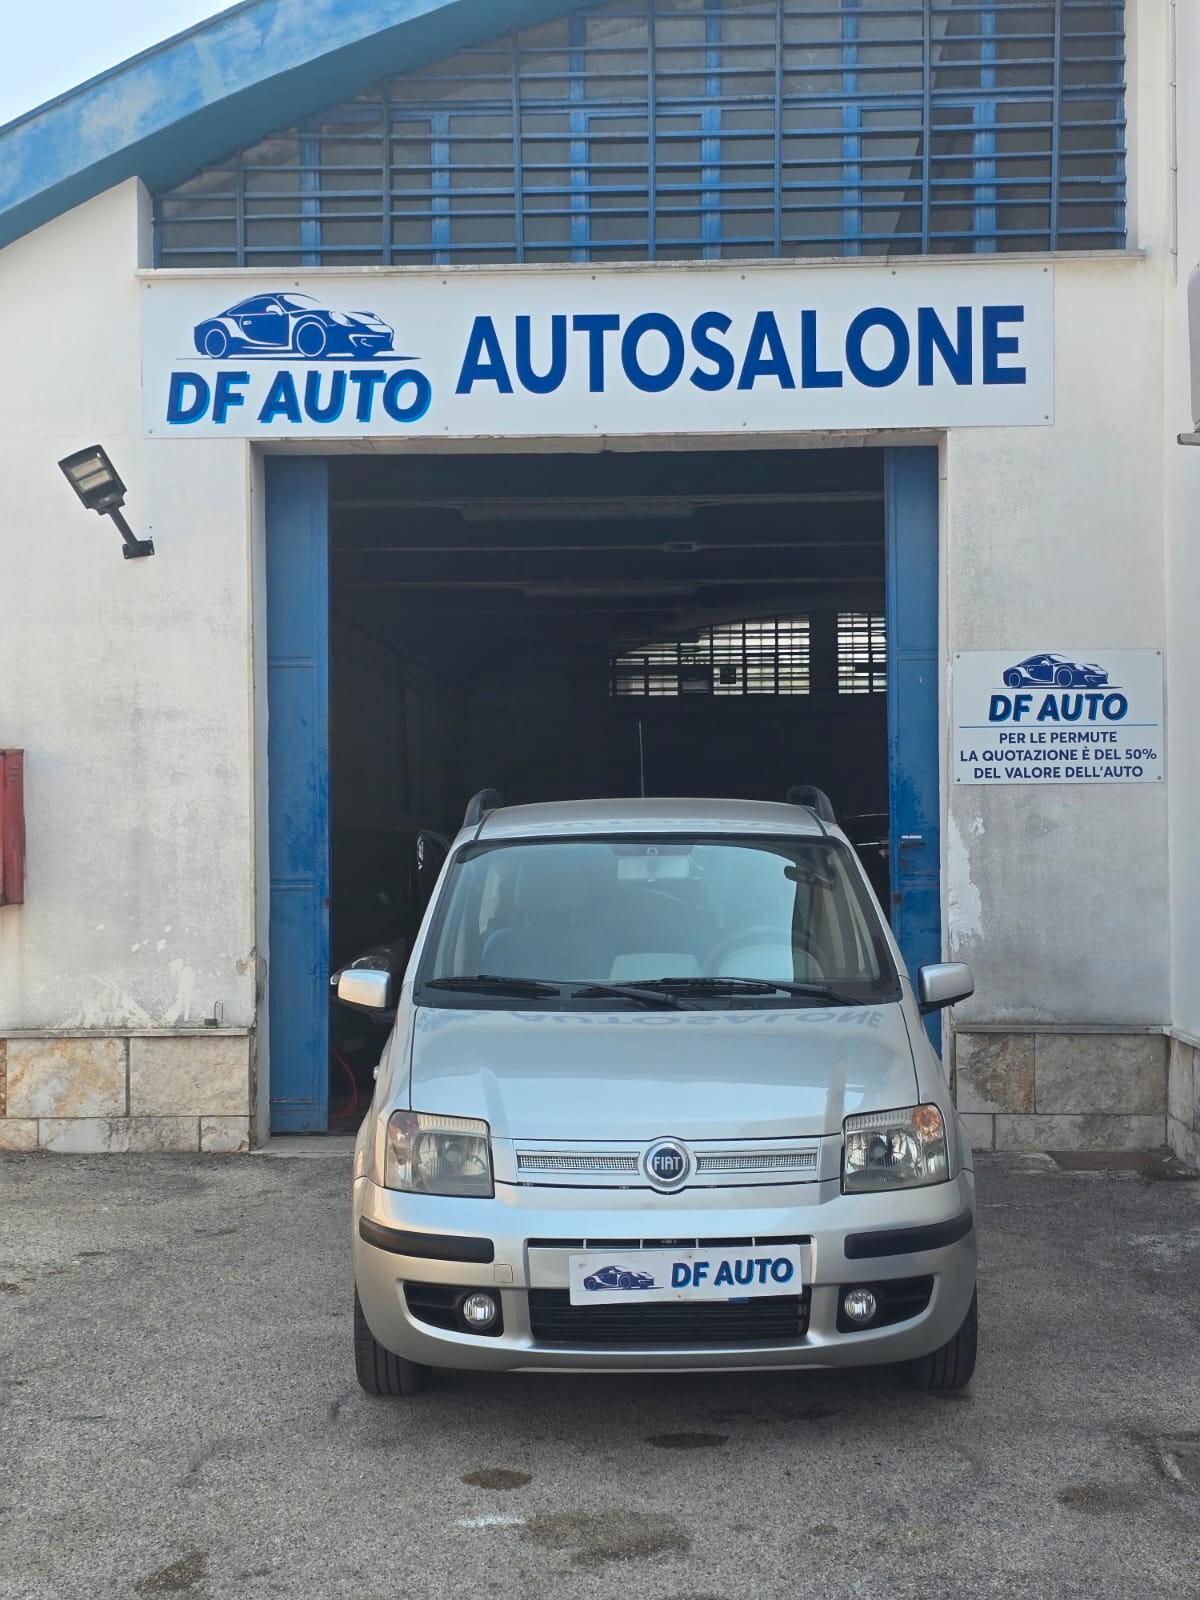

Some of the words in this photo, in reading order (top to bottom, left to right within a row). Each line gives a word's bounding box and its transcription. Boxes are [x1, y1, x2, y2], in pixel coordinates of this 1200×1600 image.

[455, 305, 1026, 394] AUTOSALONE
[166, 371, 250, 425] DF
[257, 369, 432, 424] AUTO
[988, 694, 1033, 722] DF
[1036, 692, 1128, 721] AUTO
[999, 732, 1026, 744] PER
[1030, 732, 1046, 744] LE
[1050, 731, 1117, 743] PERMUTE
[960, 749, 978, 761] LA
[982, 748, 1078, 761] QUOTAZIONE
[1082, 746, 1090, 760] È
[1094, 748, 1121, 760] DEL
[1125, 747, 1157, 760] 50%
[974, 767, 1001, 779] DEL
[1004, 766, 1061, 778] VALORE
[1065, 765, 1143, 778] DELL'AUTO
[654, 1156, 681, 1171] FIAT
[671, 1261, 710, 1288] DF
[714, 1257, 794, 1286] AUTO
